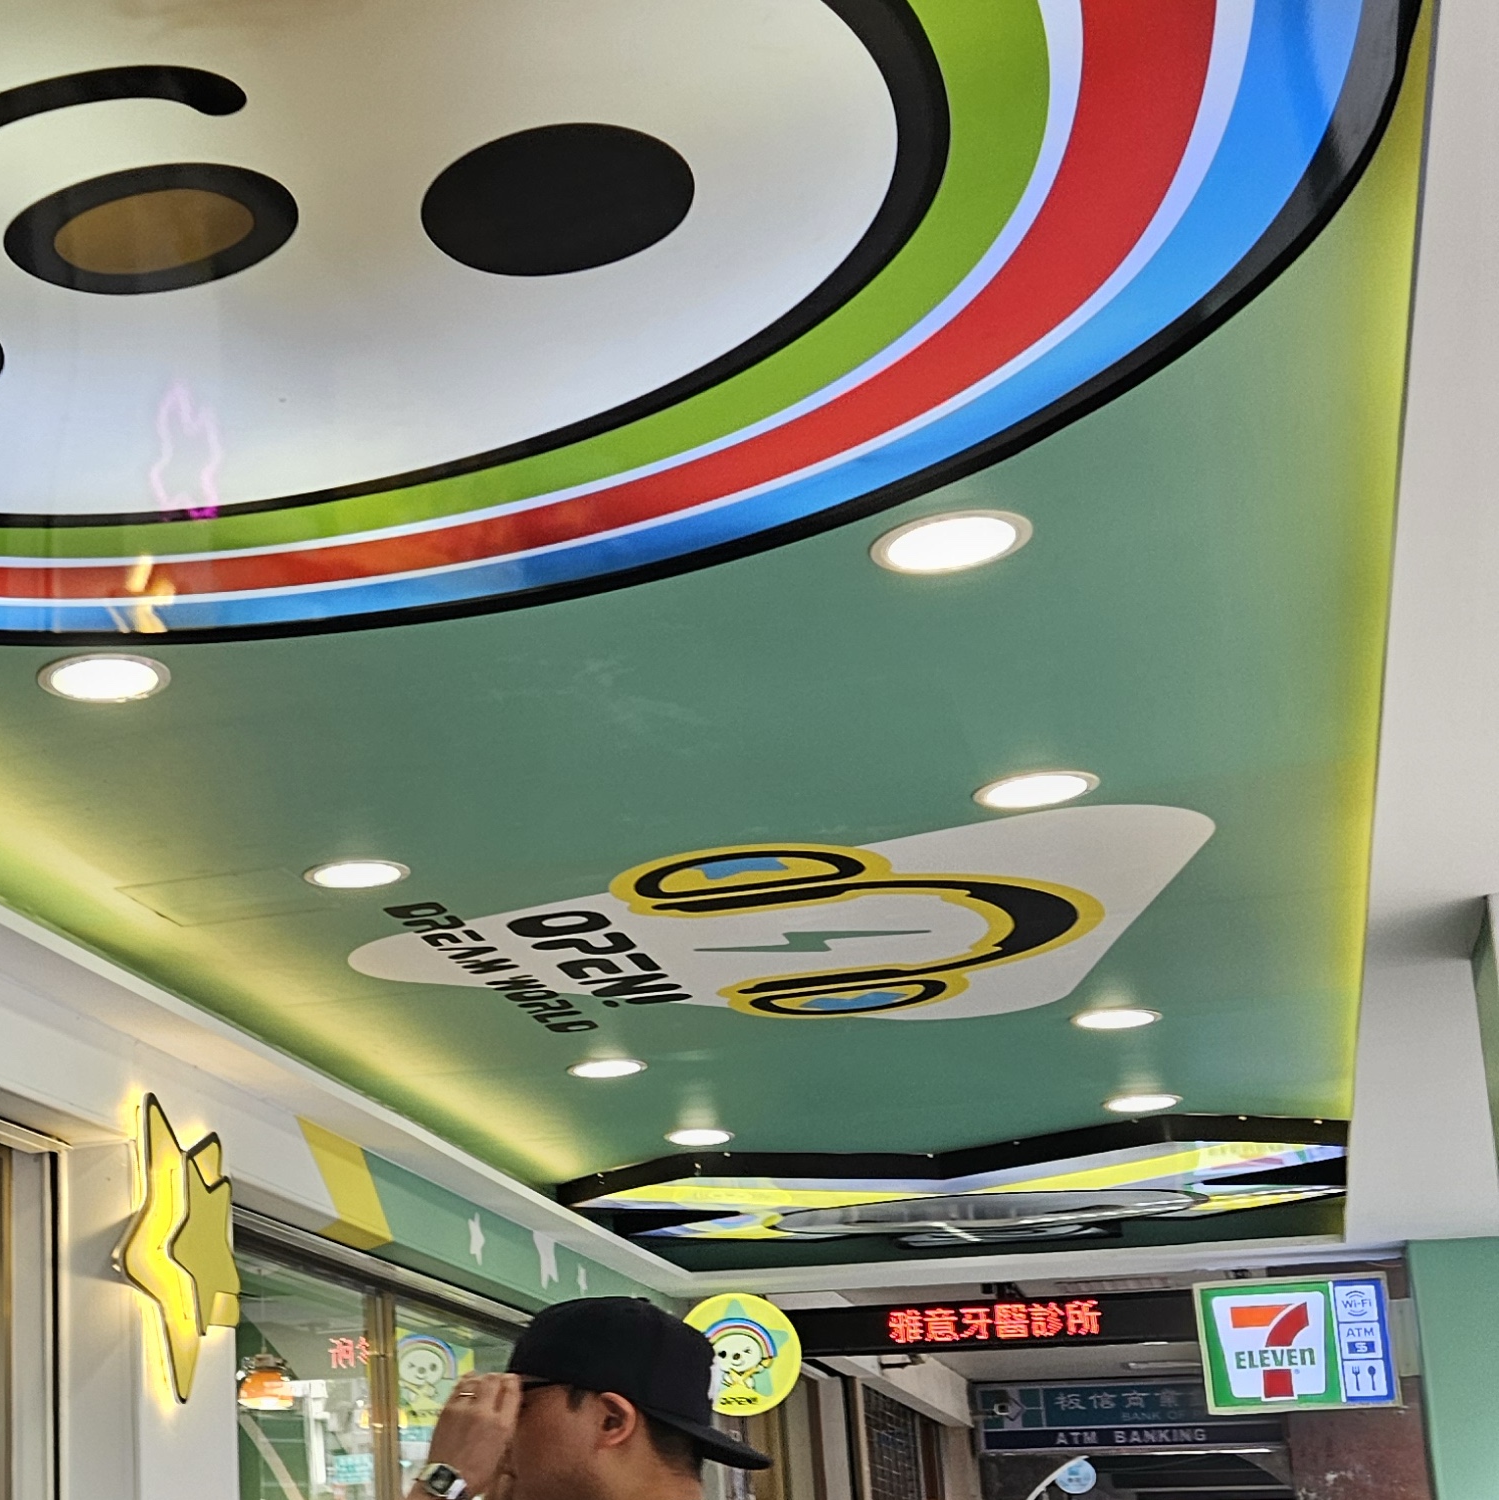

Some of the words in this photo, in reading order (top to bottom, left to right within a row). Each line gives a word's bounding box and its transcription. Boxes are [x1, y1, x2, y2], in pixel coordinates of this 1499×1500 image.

[383, 902, 520, 974] DREAM
[485, 975, 599, 1033] WORLD
[1341, 1299, 1372, 1309] Wi-Fi
[888, 1300, 1102, 1343] 雅意牙醫診所
[1346, 1327, 1375, 1338] ATM
[1121, 1411, 1162, 1422] BANK
[1056, 1432, 1099, 1446] ATM
[1114, 1428, 1207, 1444] BANKING
